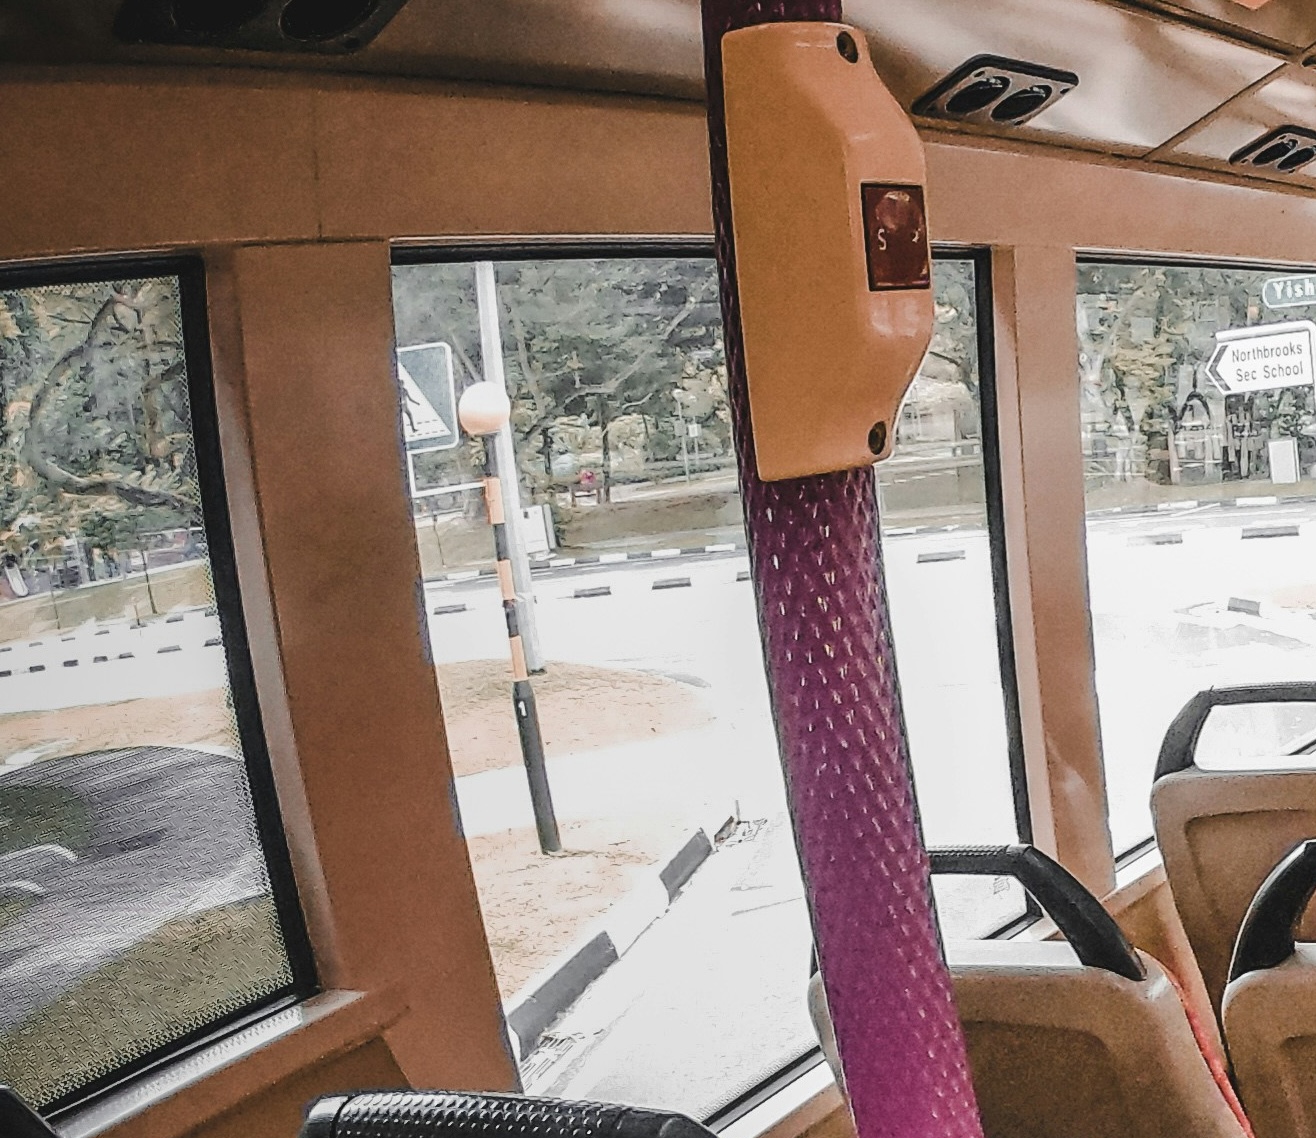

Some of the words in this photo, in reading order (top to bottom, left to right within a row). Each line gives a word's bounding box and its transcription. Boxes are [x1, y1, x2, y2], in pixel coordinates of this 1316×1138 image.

[1232, 341, 1303, 363] Northbrooks
[1236, 368, 1257, 382] Sec
[1263, 360, 1304, 379] School
